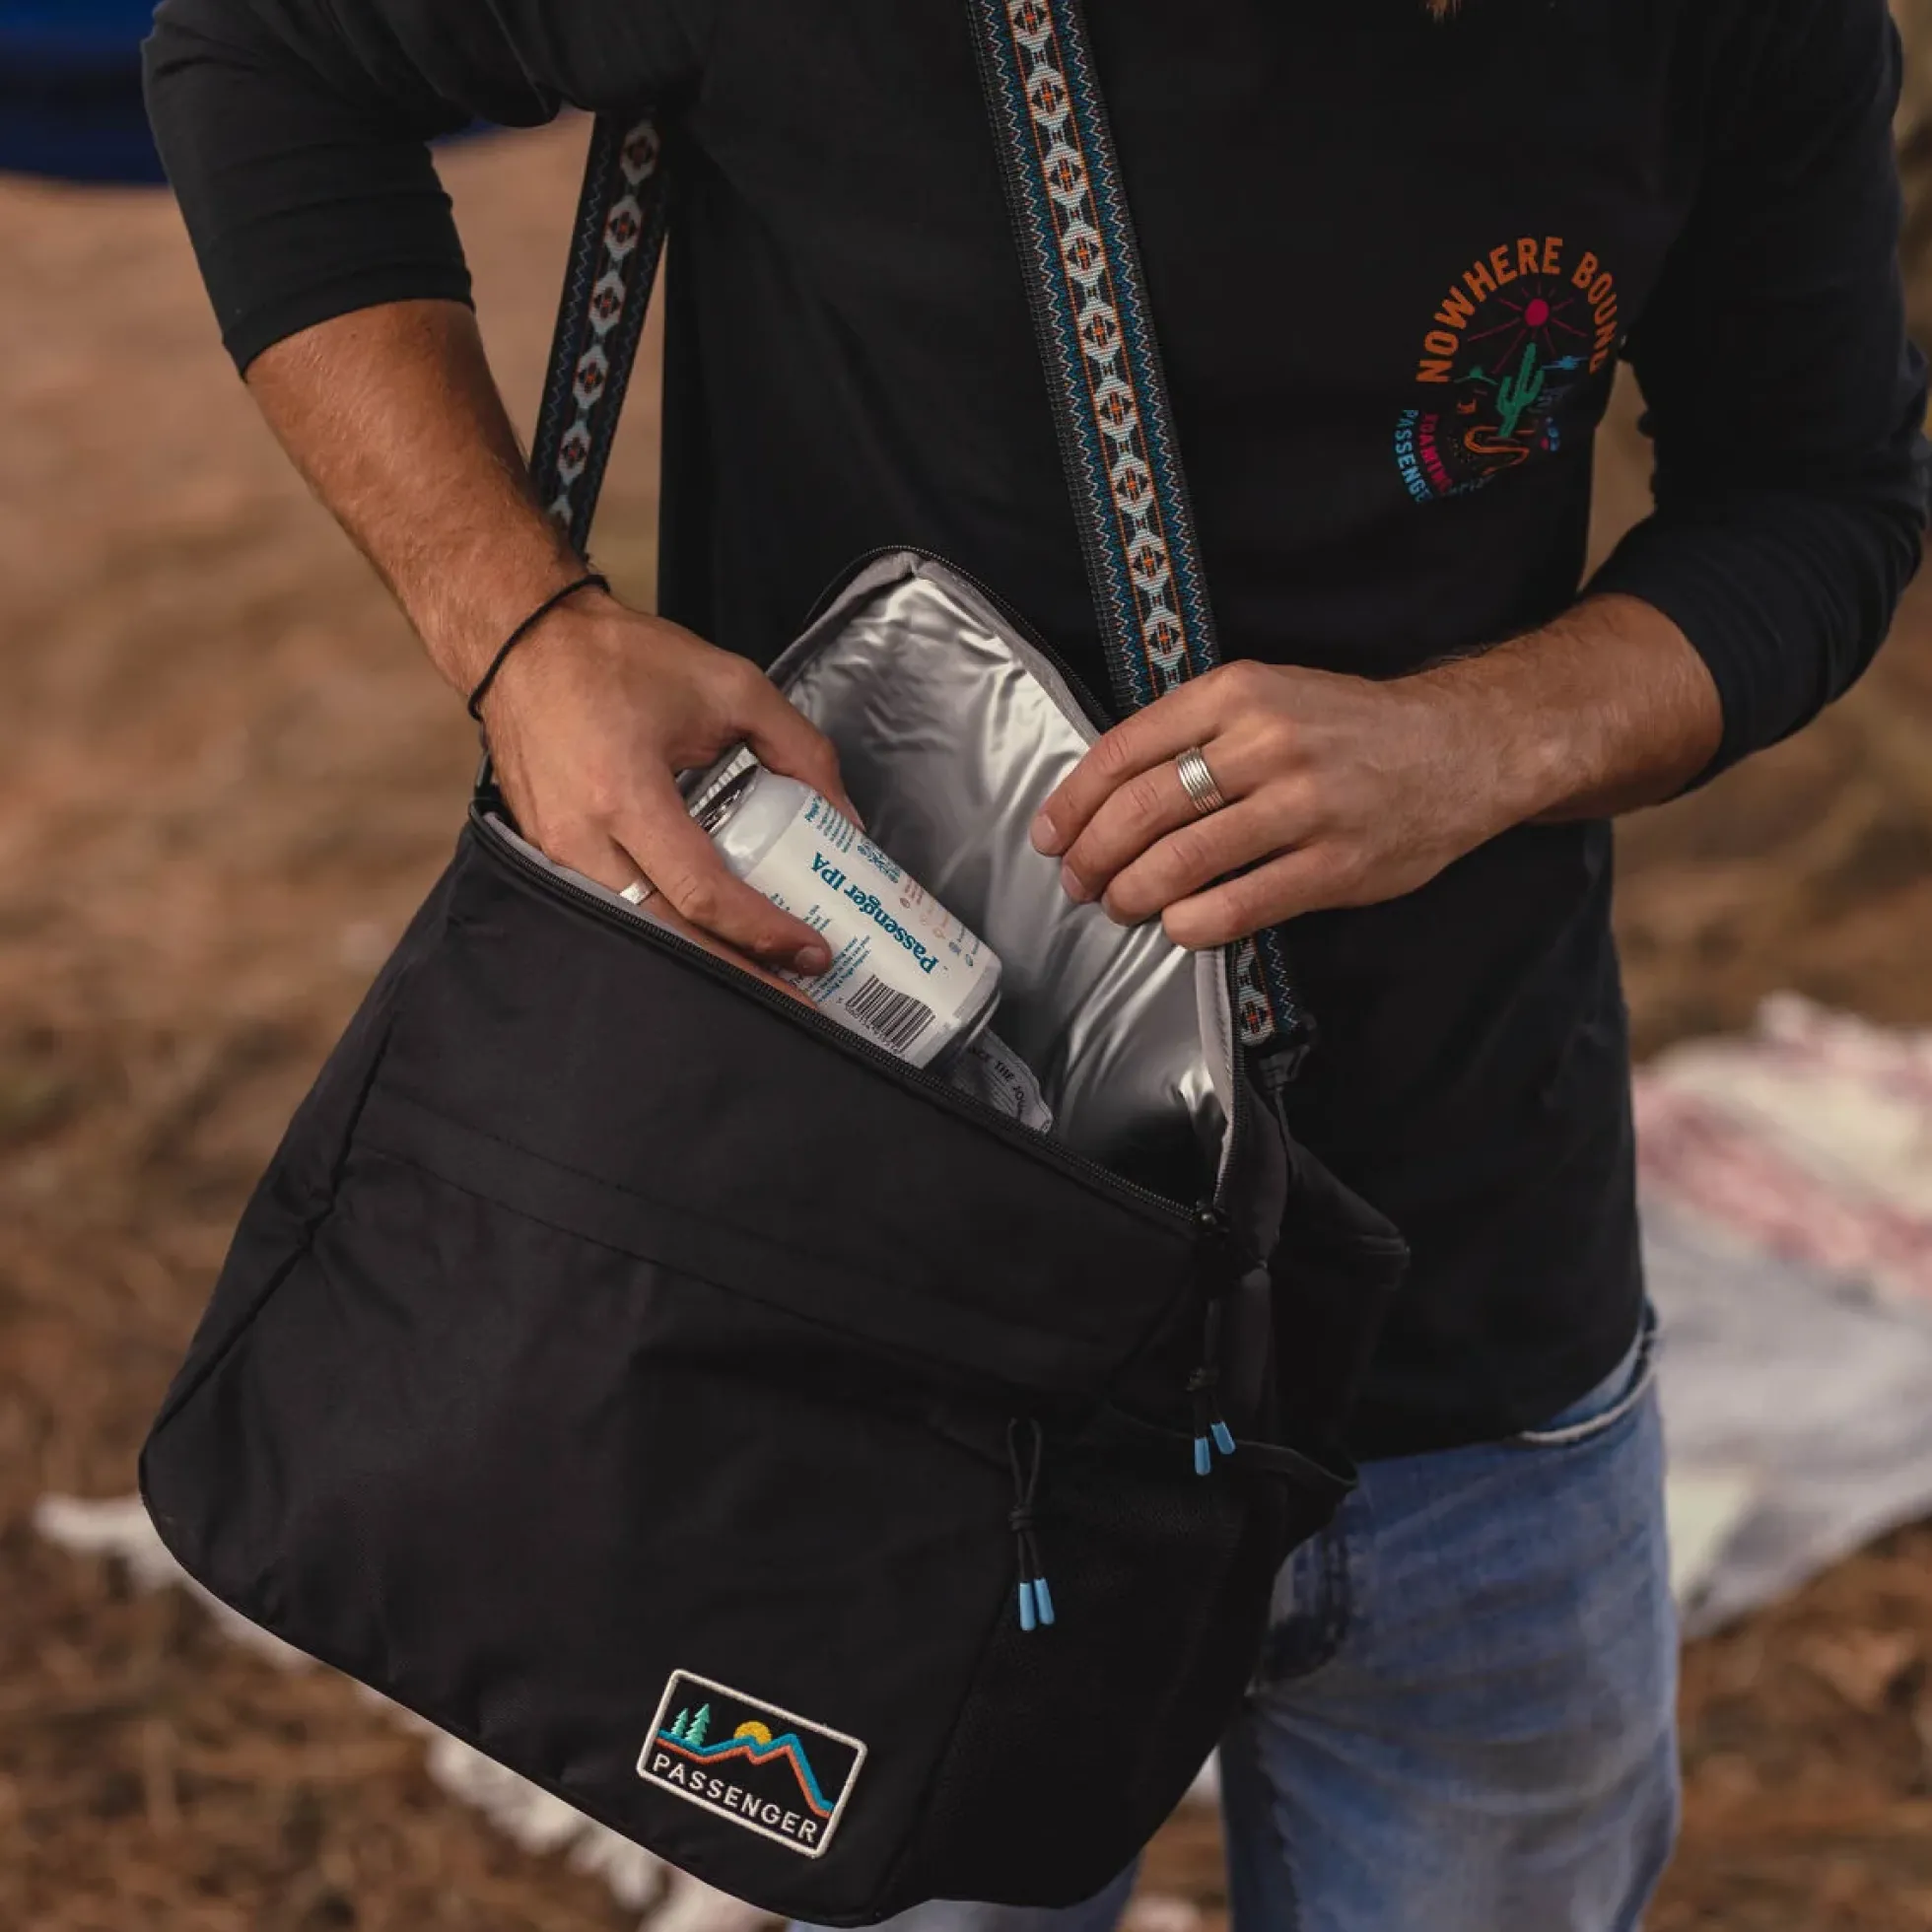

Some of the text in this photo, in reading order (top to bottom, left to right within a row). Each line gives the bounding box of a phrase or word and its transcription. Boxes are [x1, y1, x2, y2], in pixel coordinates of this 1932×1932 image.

[1415, 236, 1563, 383] NOWHERE
[810, 851, 848, 891] IPA
[843, 883, 939, 974] Passenger
[652, 1753, 818, 1843] PASSENGER
